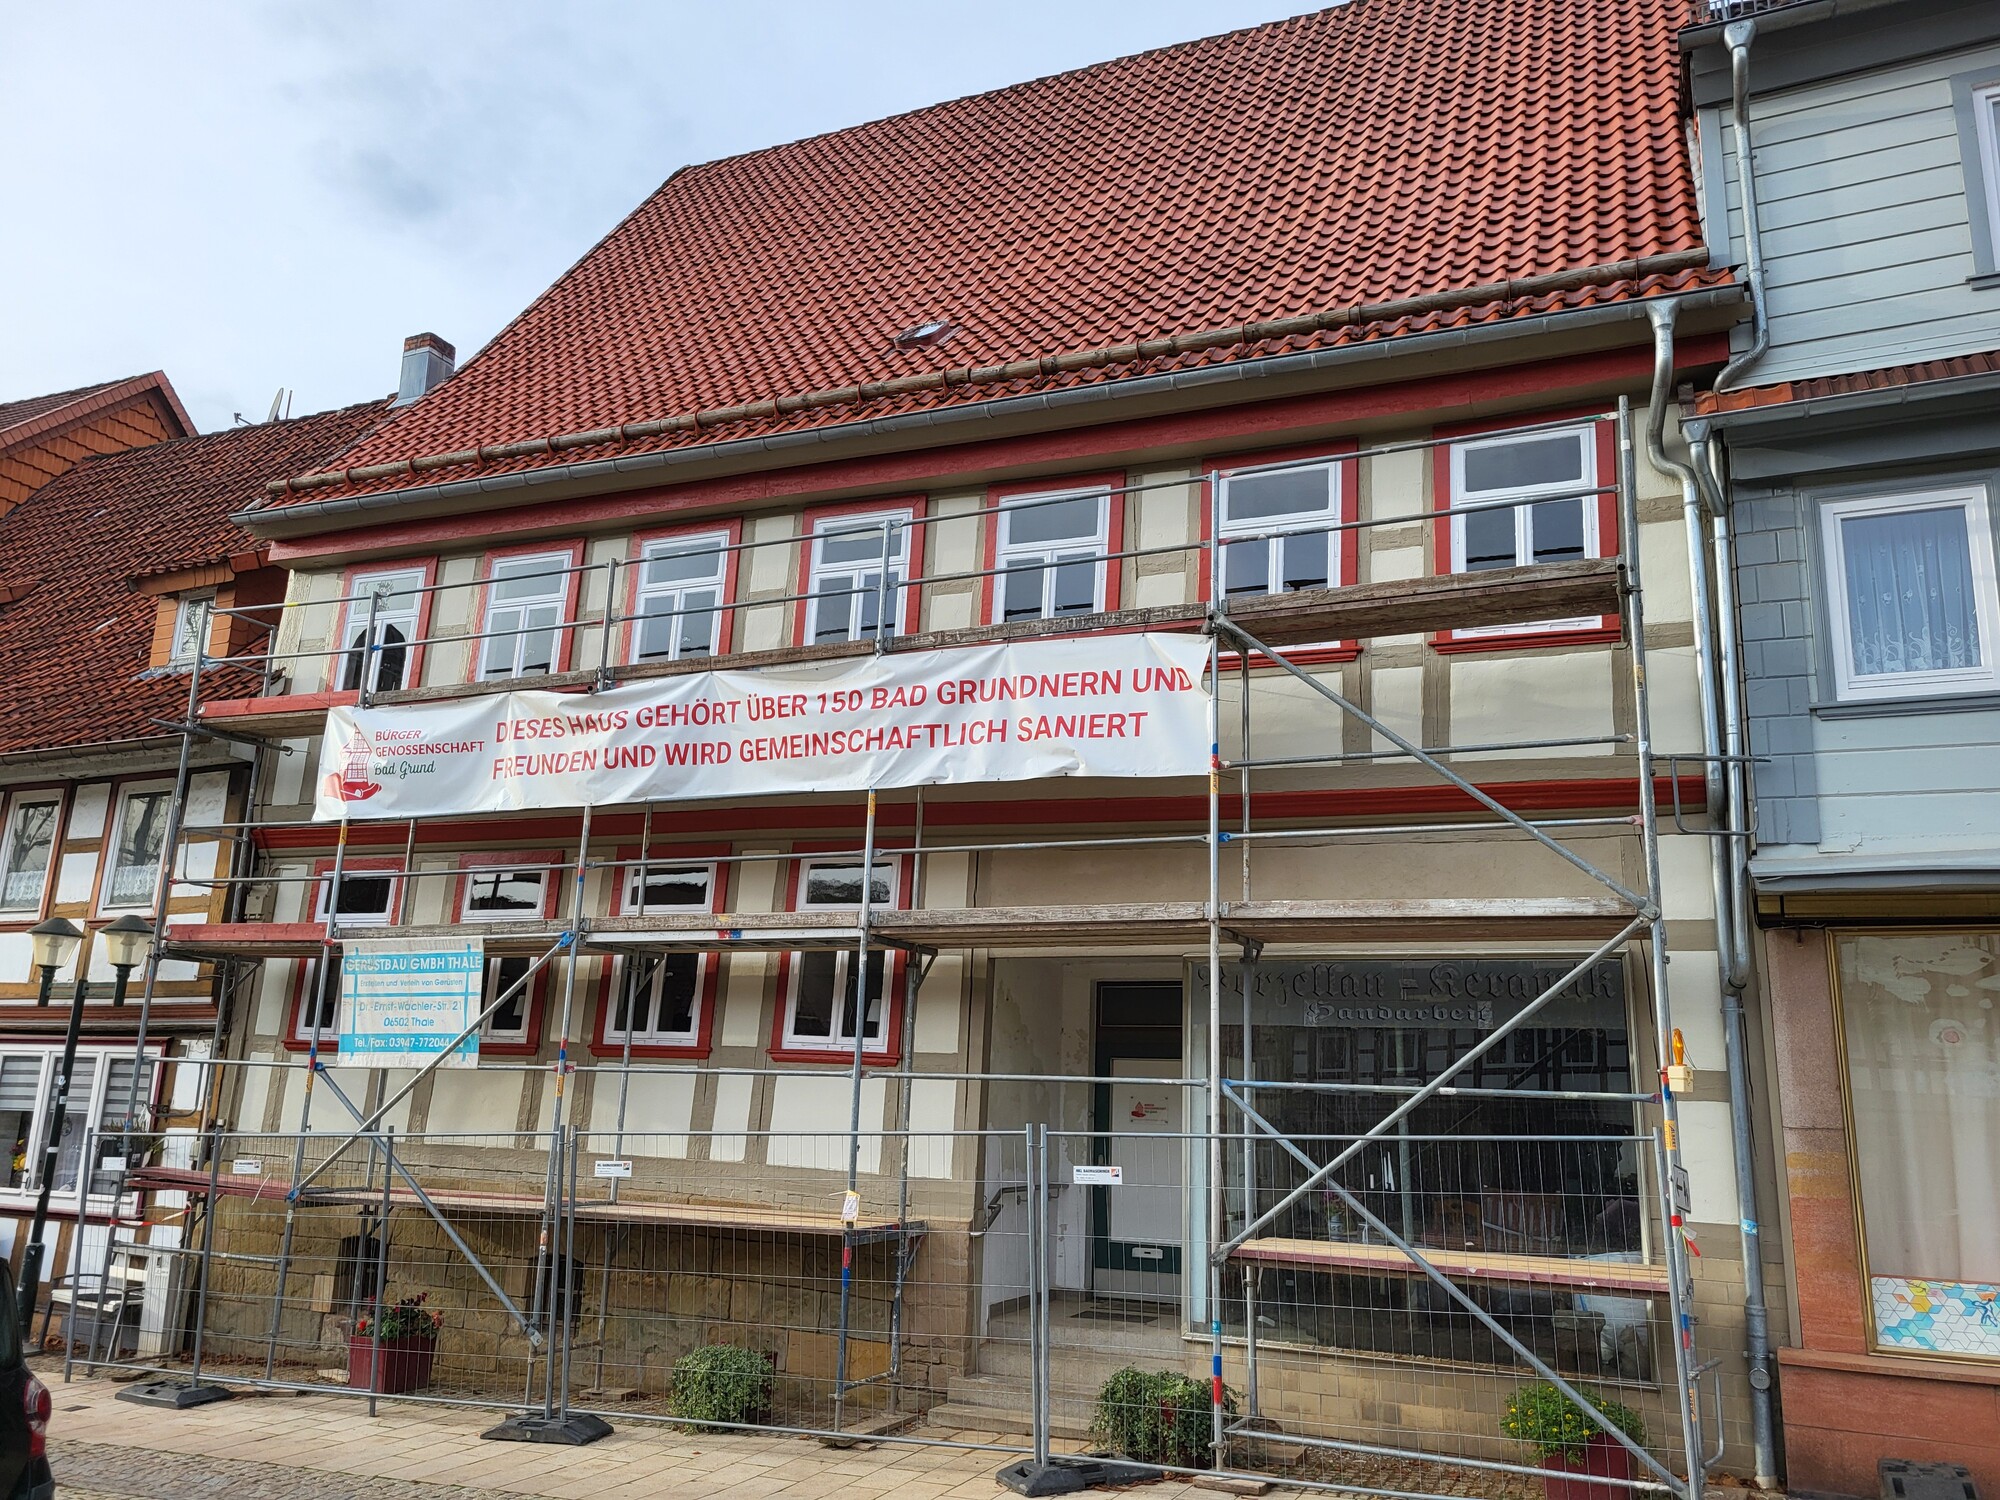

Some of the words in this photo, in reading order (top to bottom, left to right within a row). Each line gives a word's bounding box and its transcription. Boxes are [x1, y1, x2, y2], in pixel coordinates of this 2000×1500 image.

[496, 716, 565, 743] DIESES
[571, 709, 628, 736] HAUS
[636, 698, 741, 729] GEHÖRT
[748, 693, 808, 722] ÜBER
[817, 690, 861, 715] 150
[870, 685, 927, 710] BAD
[936, 669, 1122, 706] GRUNDNERN
[1132, 667, 1193, 693] UND
[375, 728, 422, 742] BÜRGER
[375, 740, 485, 758] GENOSSENSCHAFT
[492, 748, 598, 780] FREUNDEN
[603, 745, 656, 769] UND
[664, 742, 732, 767] WIRD
[739, 718, 1008, 763] GEMEINSCHAFTLICH
[1016, 711, 1149, 742] SANIERT
[374, 761, 397, 776] Bad
[399, 760, 436, 779] Grund
[346, 958, 407, 971] GERÜSTBAU
[410, 957, 445, 970] GMBH
[447, 956, 482, 969] THALE
[383, 1017, 409, 1027] 06502
[411, 1016, 435, 1027] Thale
